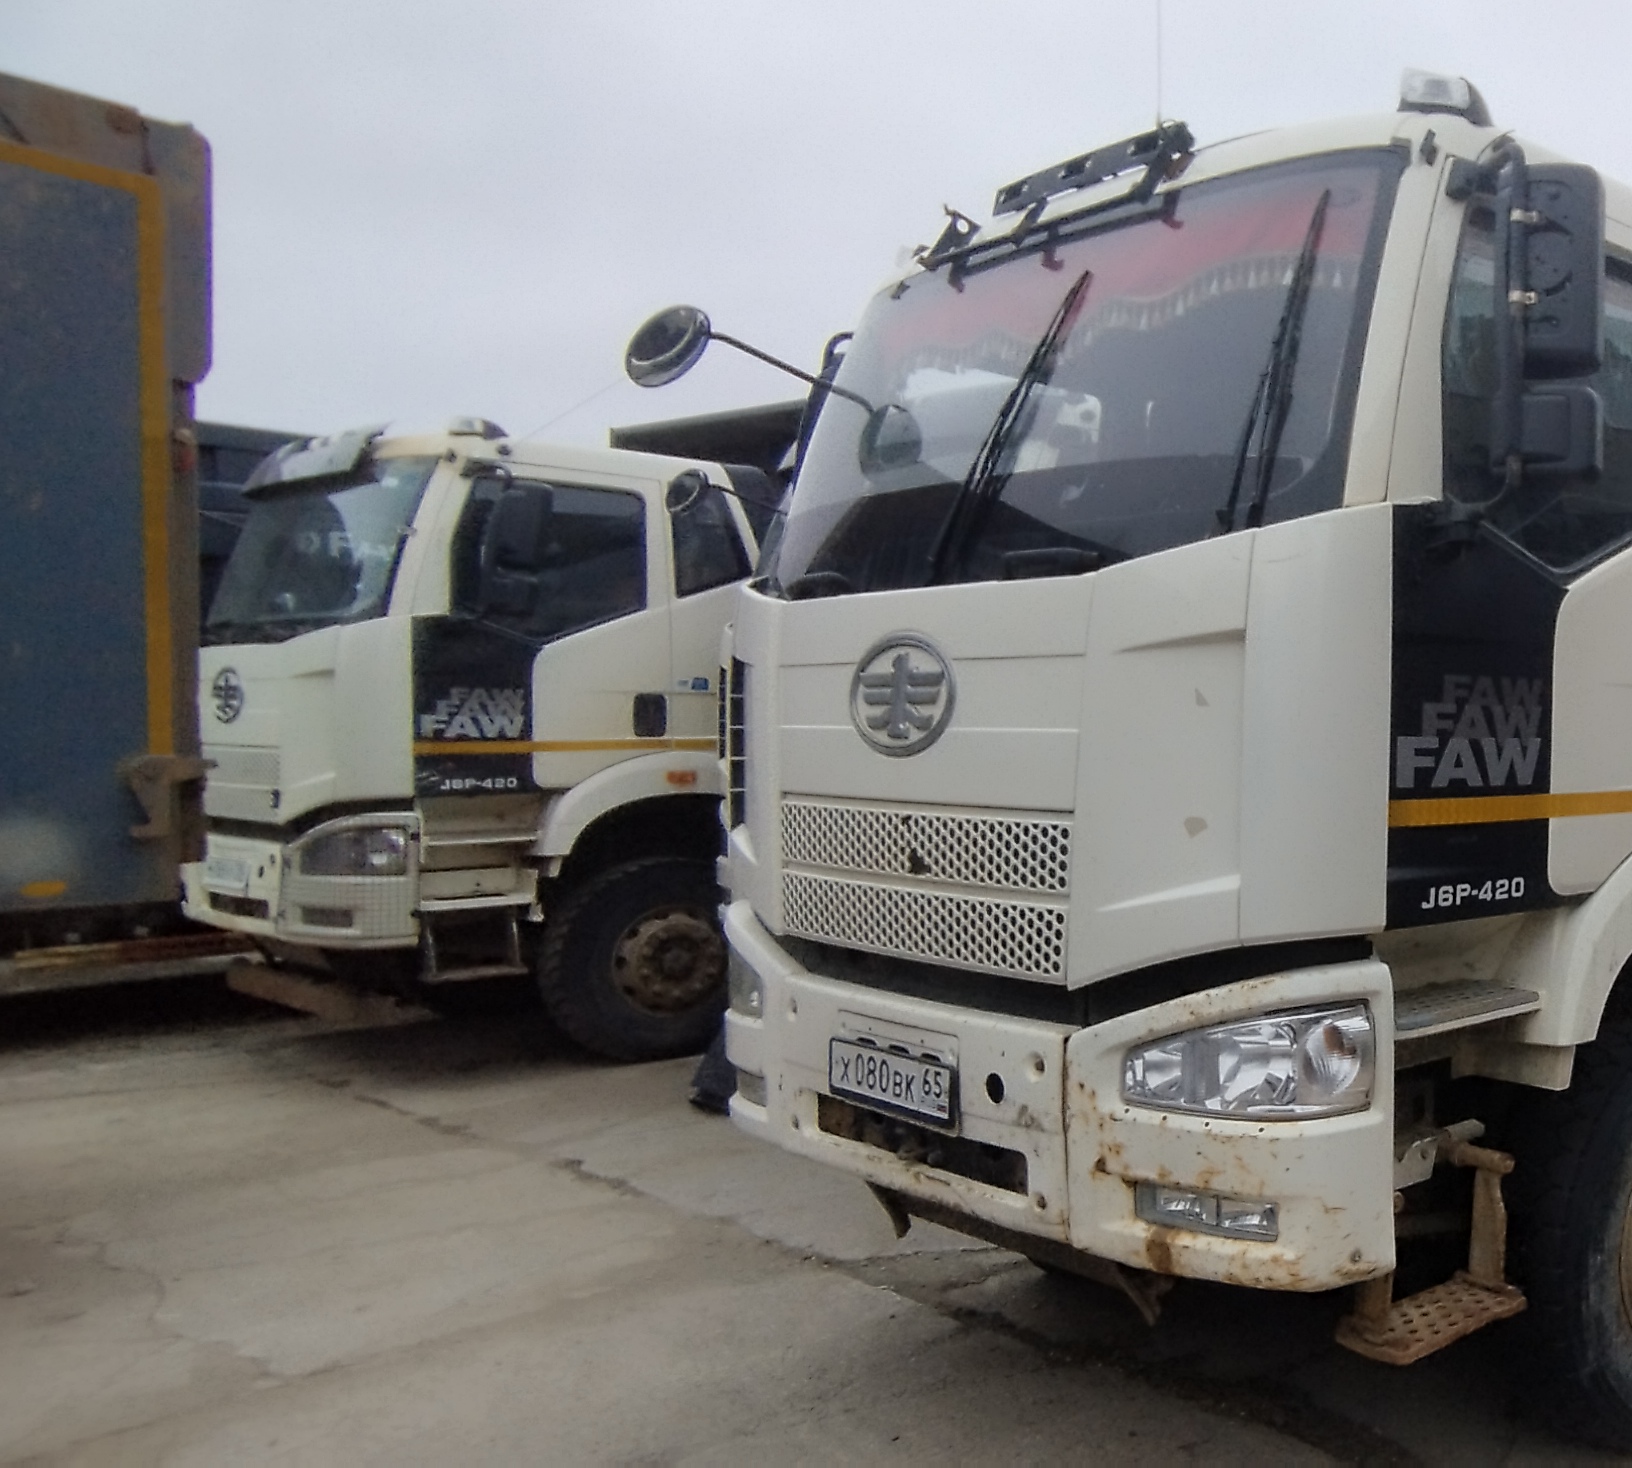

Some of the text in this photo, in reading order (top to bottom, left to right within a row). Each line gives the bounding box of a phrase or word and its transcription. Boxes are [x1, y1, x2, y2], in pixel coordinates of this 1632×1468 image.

[1443, 675, 1543, 706] FAW
[419, 713, 525, 738] FAW
[1421, 702, 1542, 740] FAW
[1396, 736, 1542, 788] FAW
[1421, 877, 1525, 909] J6P-420
[922, 1068, 943, 1098] 65
